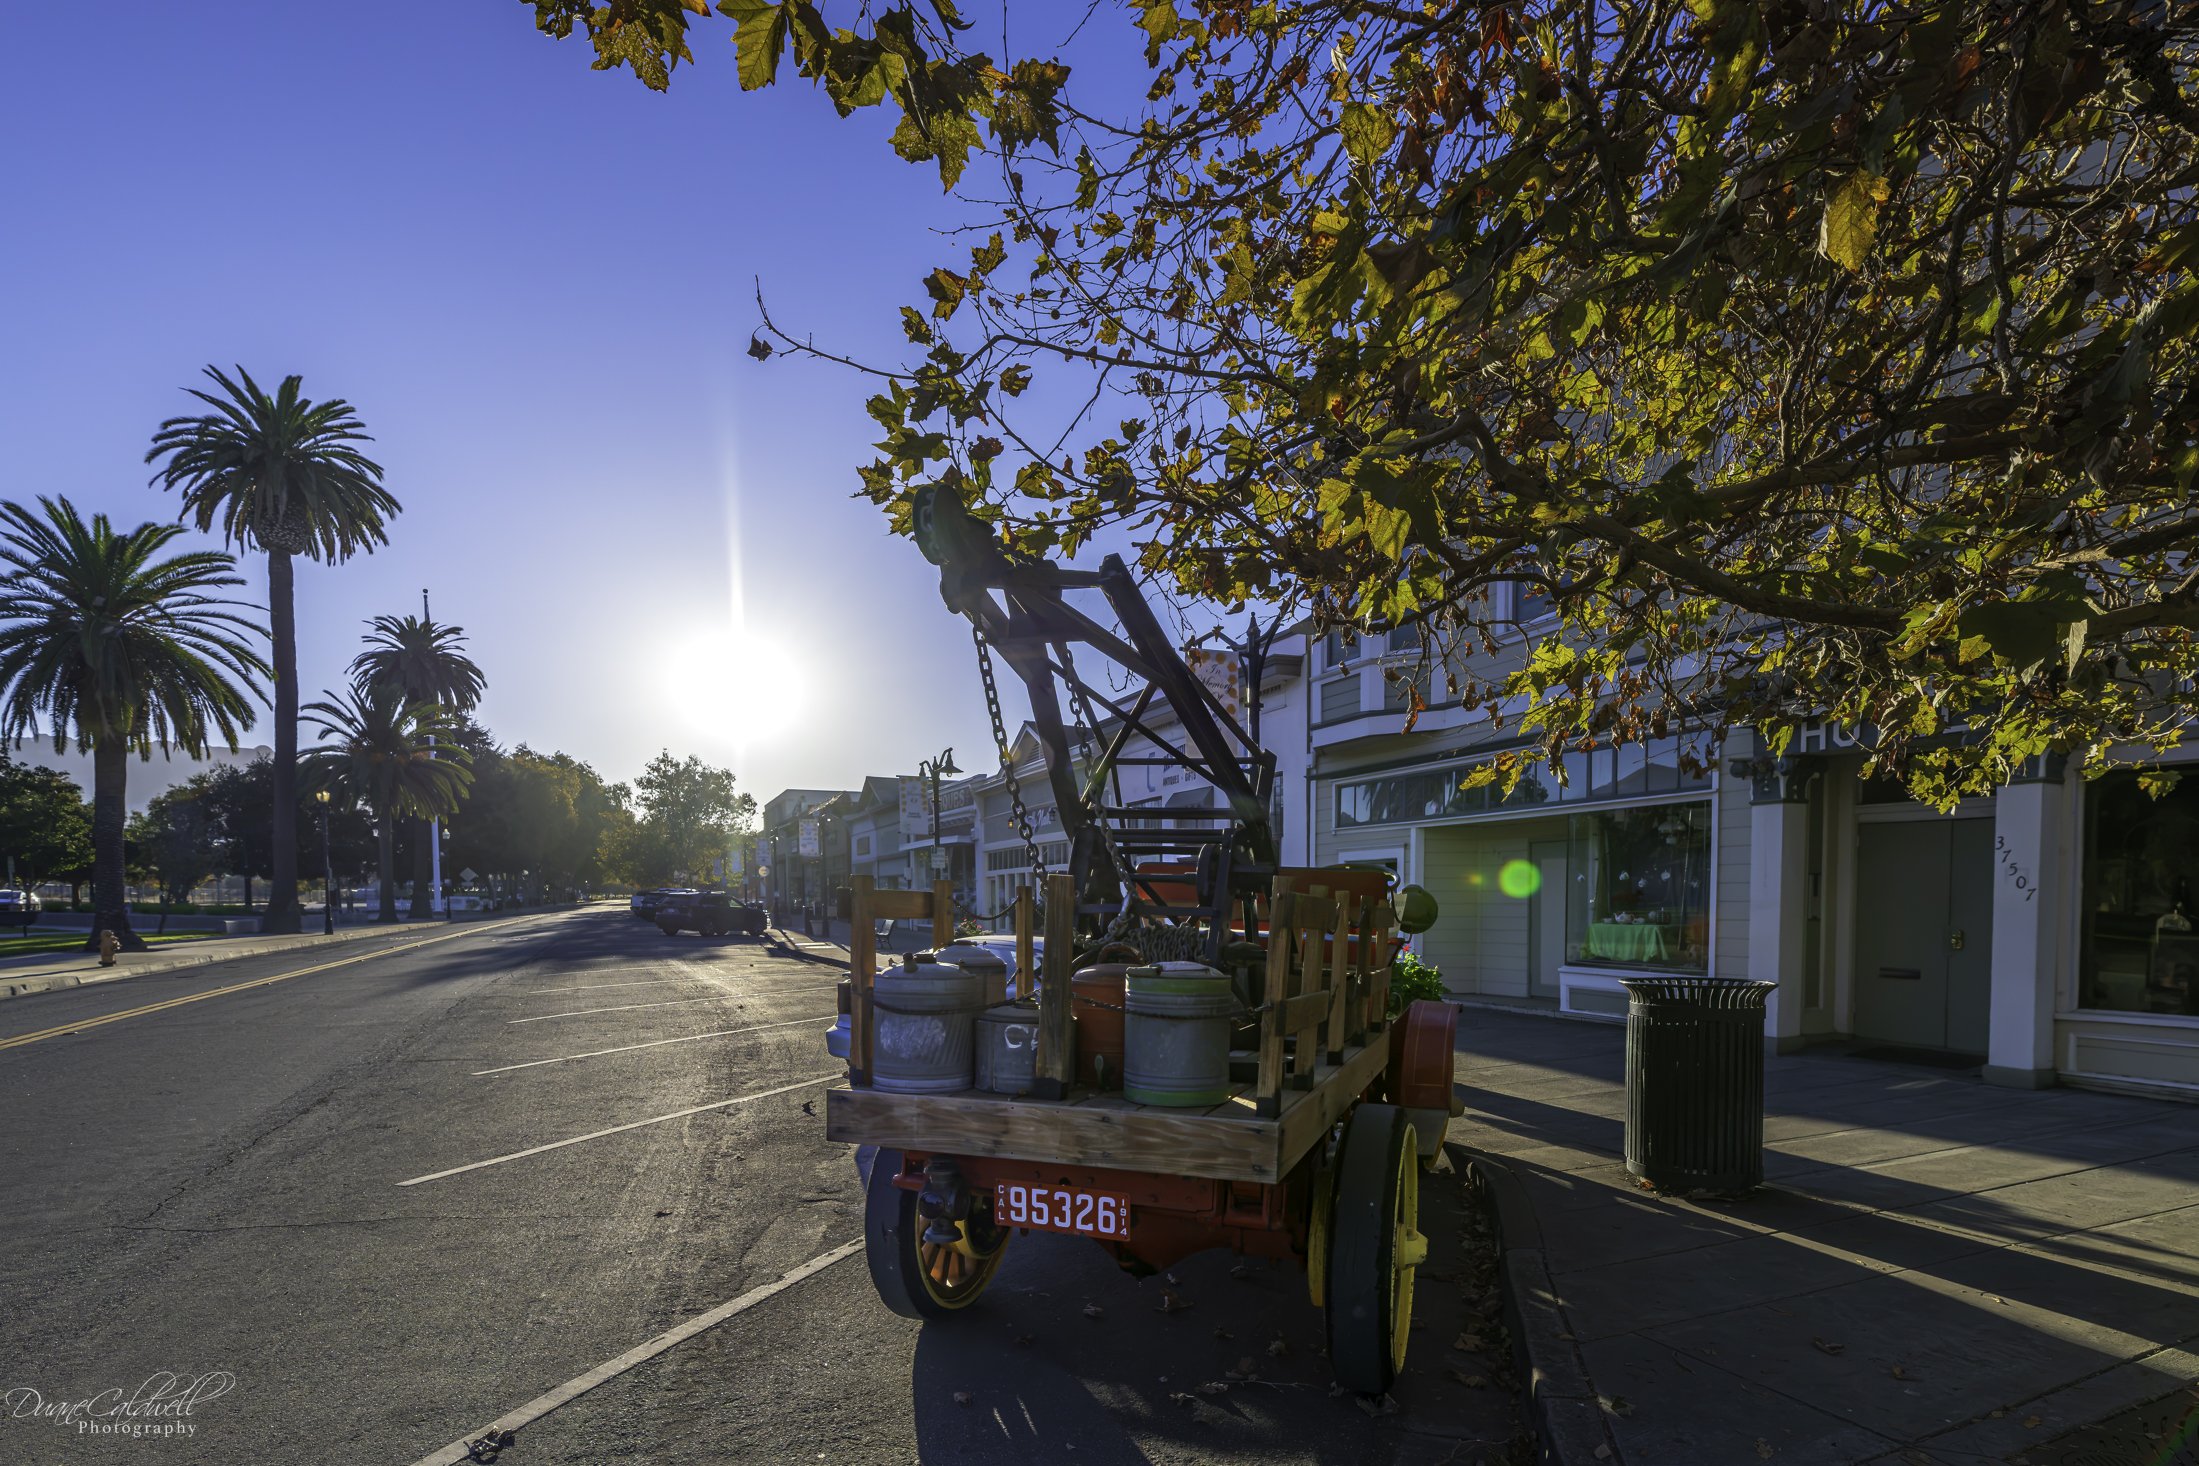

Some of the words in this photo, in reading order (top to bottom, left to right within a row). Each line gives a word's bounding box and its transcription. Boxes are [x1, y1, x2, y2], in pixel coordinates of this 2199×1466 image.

[1995, 835, 2037, 902] 37507
[1010, 1186, 1116, 1234] 95326
[1119, 1198, 1128, 1236] 1914
